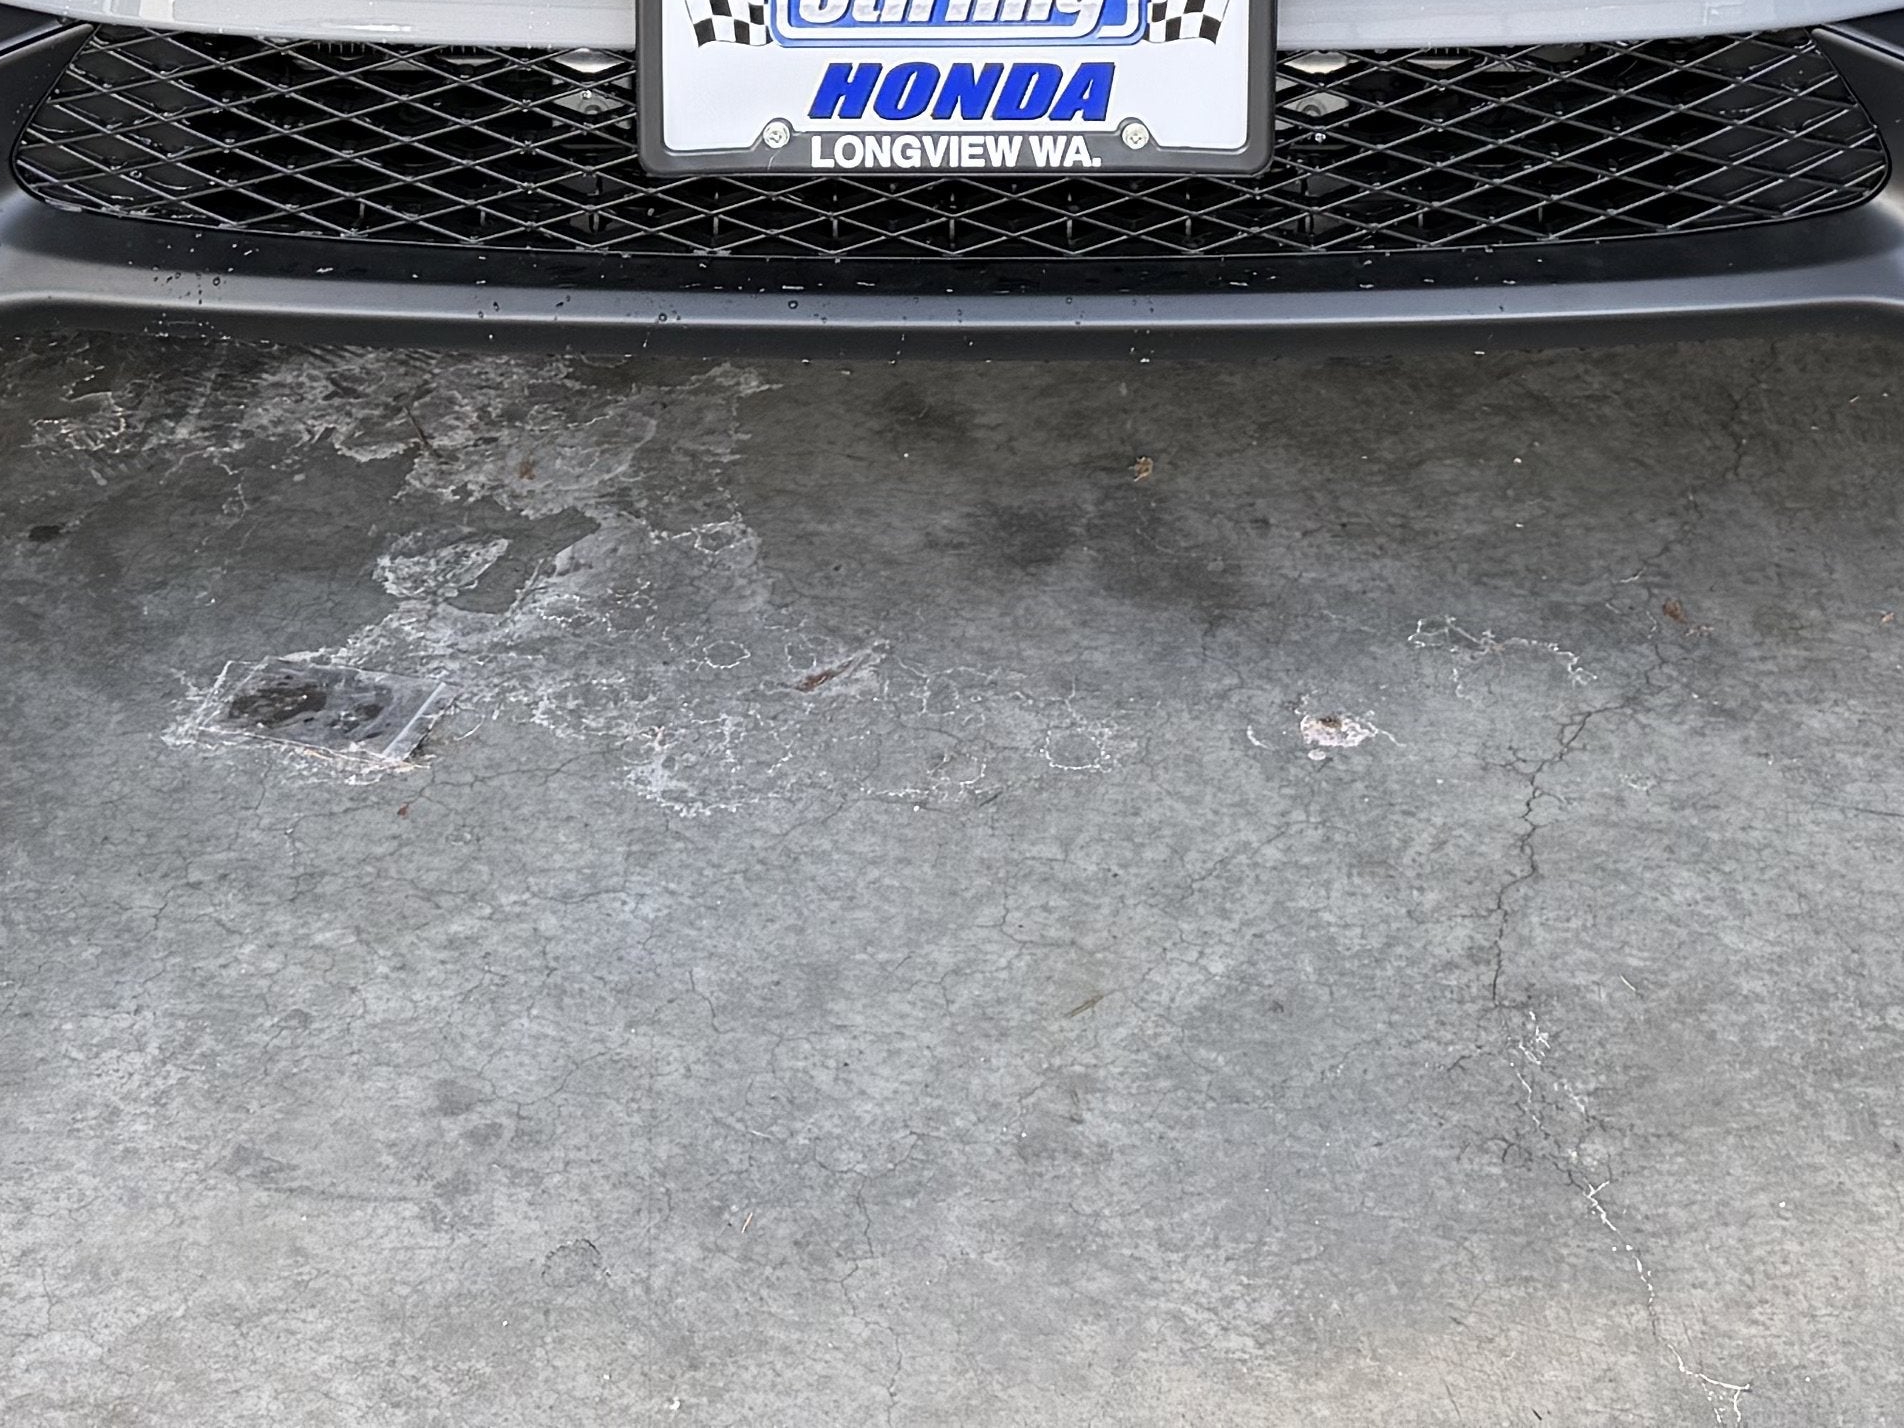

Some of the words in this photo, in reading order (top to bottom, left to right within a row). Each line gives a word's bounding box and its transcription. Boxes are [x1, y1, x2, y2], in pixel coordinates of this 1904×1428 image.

[807, 61, 1116, 122] HONDA
[810, 134, 1022, 169] LONGVIEW
[1028, 134, 1102, 169] WA.
